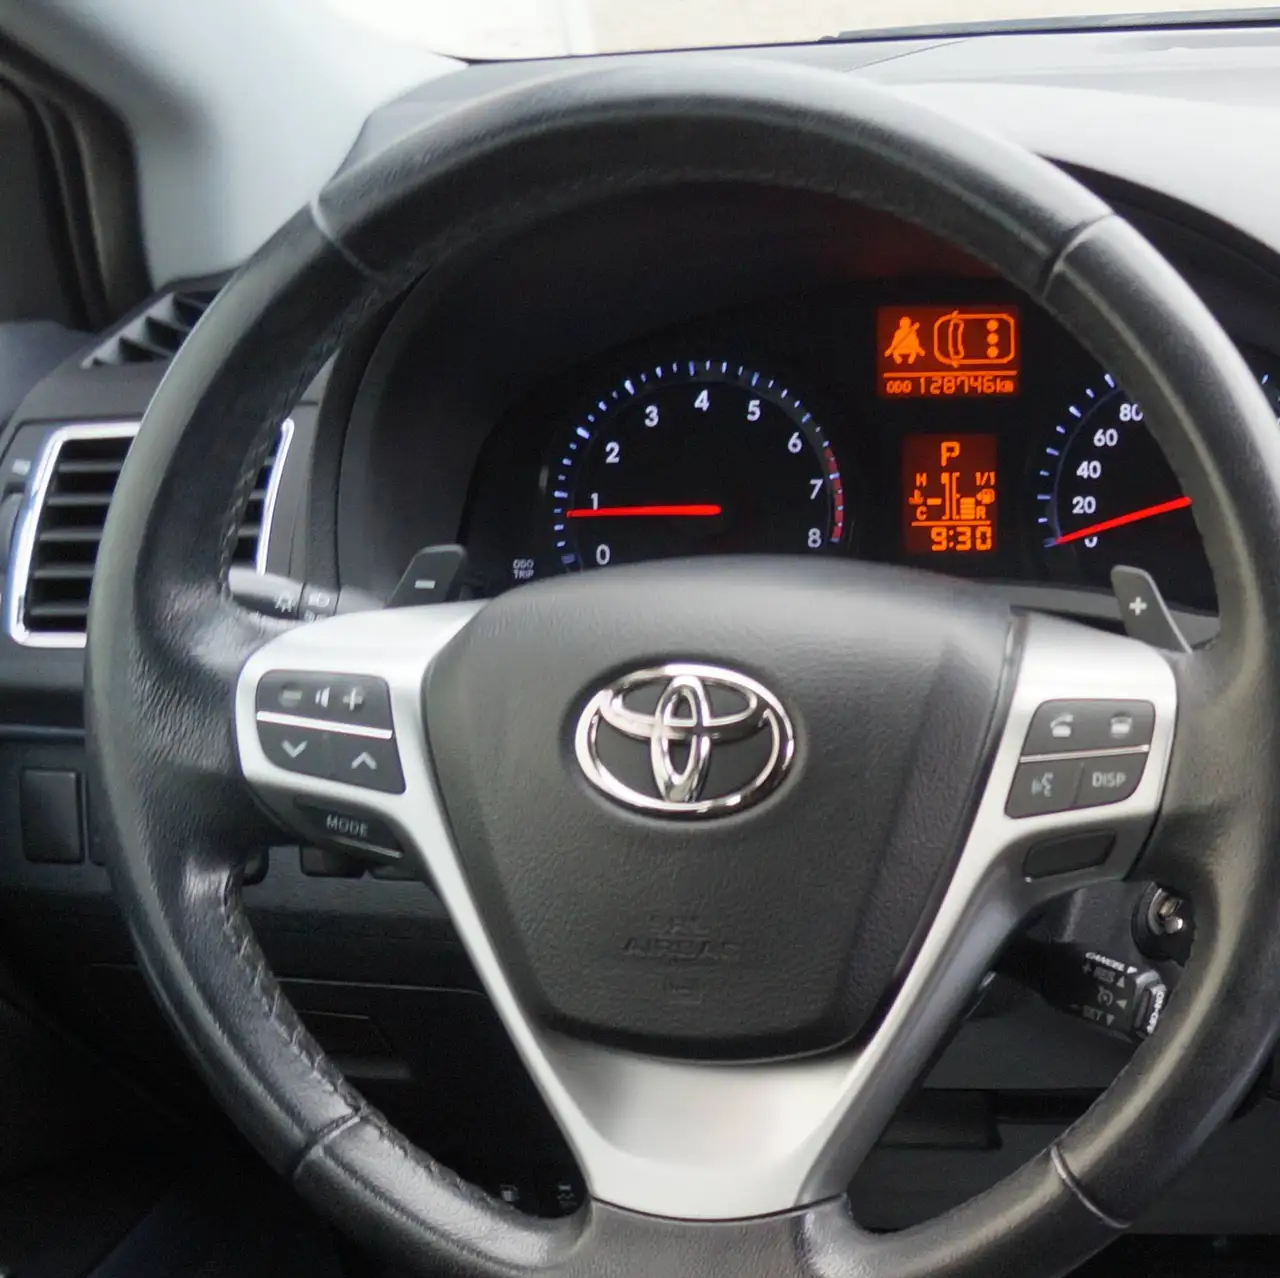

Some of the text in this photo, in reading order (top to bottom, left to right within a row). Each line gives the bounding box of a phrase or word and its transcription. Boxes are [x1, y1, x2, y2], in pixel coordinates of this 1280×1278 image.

[694, 390, 710, 412] 4
[746, 400, 762, 422] 5
[644, 405, 660, 428] 3
[787, 432, 803, 454] 6
[1093, 428, 1119, 447] 60
[604, 441, 620, 464] 2
[940, 441, 961, 467] P
[915, 471, 927, 487] H
[1076, 461, 1101, 480] 40
[809, 479, 823, 500] 7
[590, 492, 599, 510] 1
[1072, 496, 1097, 515] 20
[916, 505, 928, 520] C
[807, 527, 822, 549] 8
[930, 526, 993, 552] 9:30
[596, 544, 611, 566] 0
[1092, 772, 1127, 788] DISP
[325, 814, 370, 837] MODE
